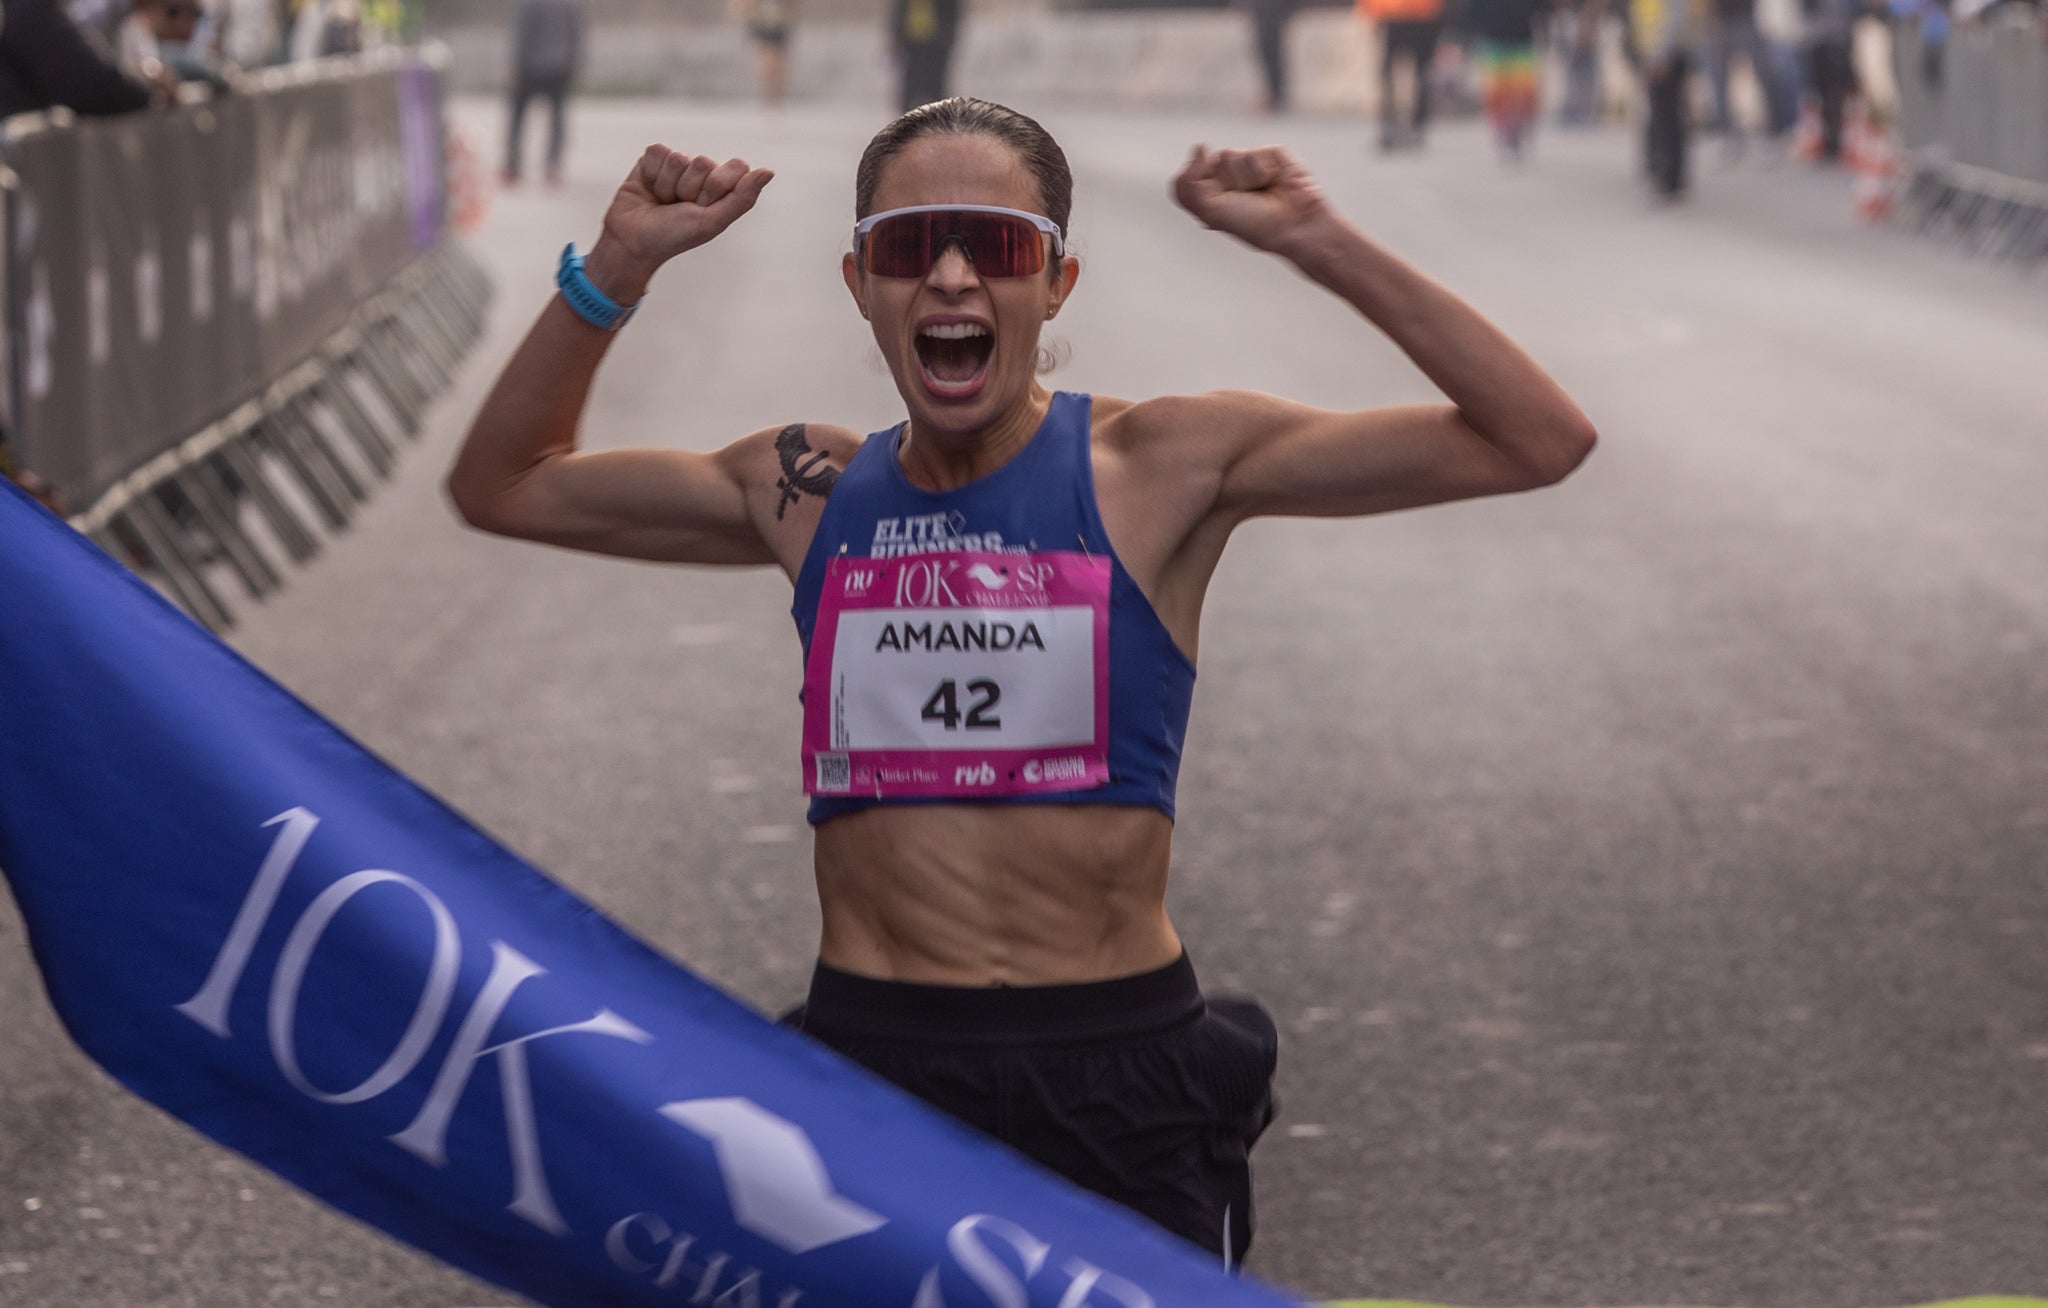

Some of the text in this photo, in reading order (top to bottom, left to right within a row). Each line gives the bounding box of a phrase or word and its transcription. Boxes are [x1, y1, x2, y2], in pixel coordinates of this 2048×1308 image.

[873, 512, 948, 543] ELITE
[894, 560, 1055, 608] 10K SP
[875, 620, 1047, 653] AMANDA
[920, 677, 1002, 731] 42
[172, 805, 656, 1238] 10K
